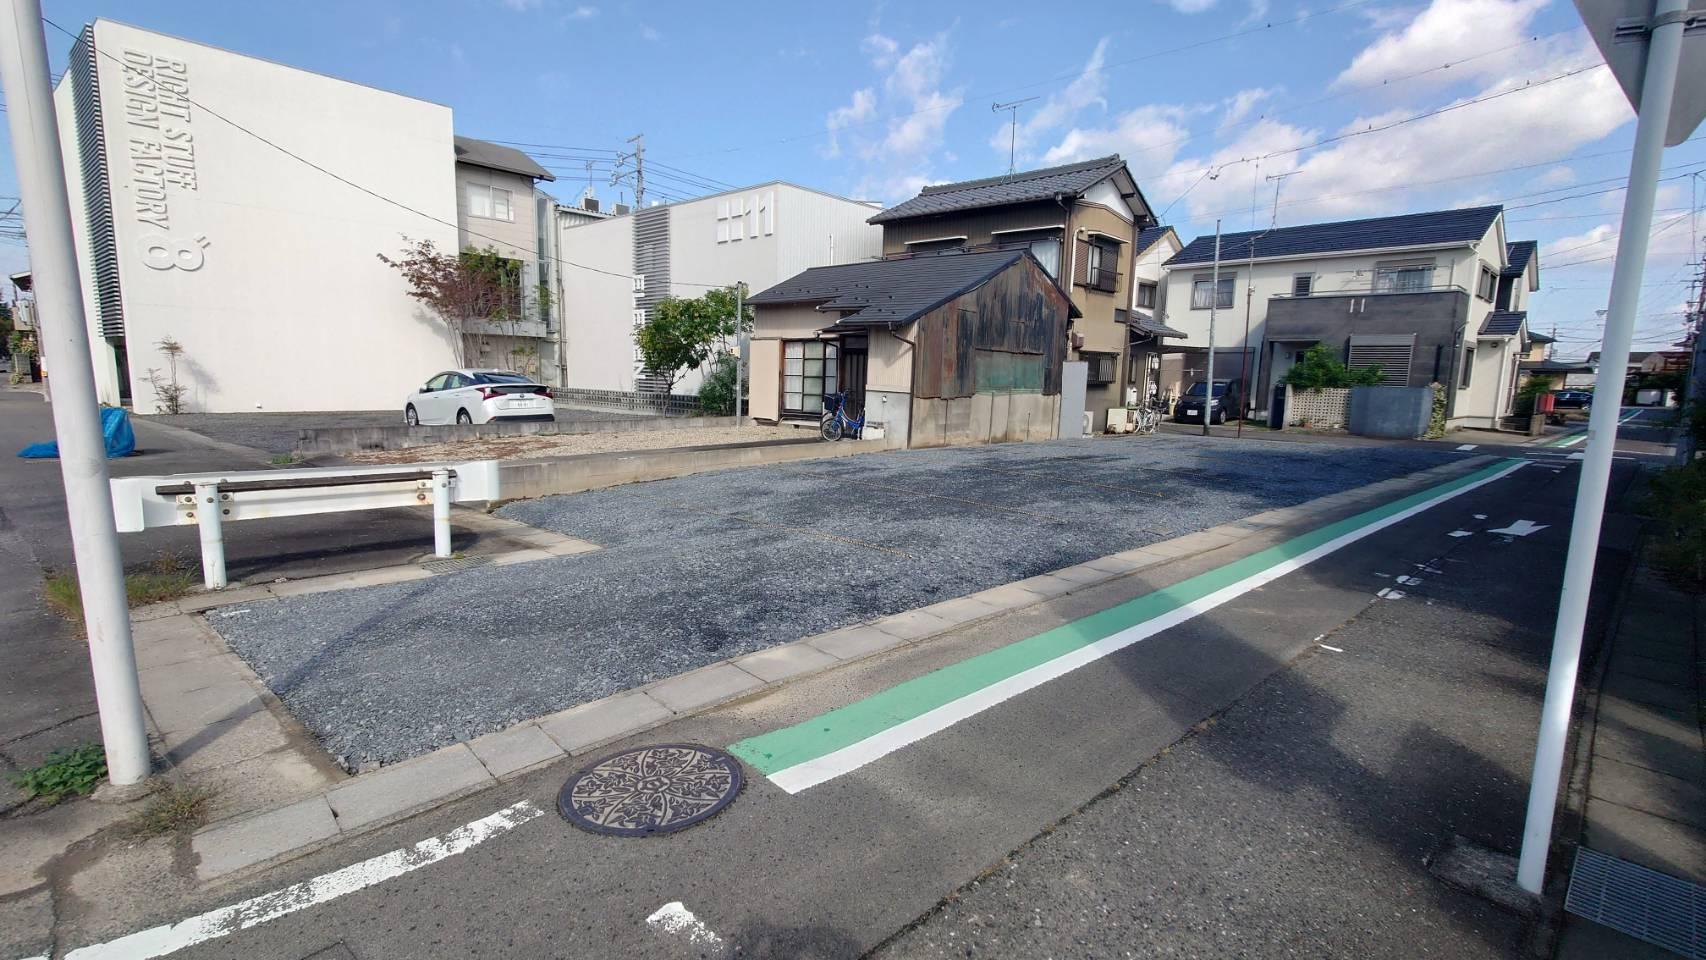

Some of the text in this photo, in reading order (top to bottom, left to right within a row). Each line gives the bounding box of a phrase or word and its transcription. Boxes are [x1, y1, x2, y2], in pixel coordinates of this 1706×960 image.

[123, 49, 169, 230] DESIGN FACTORY
[155, 58, 198, 191] RIGHT STUFF
